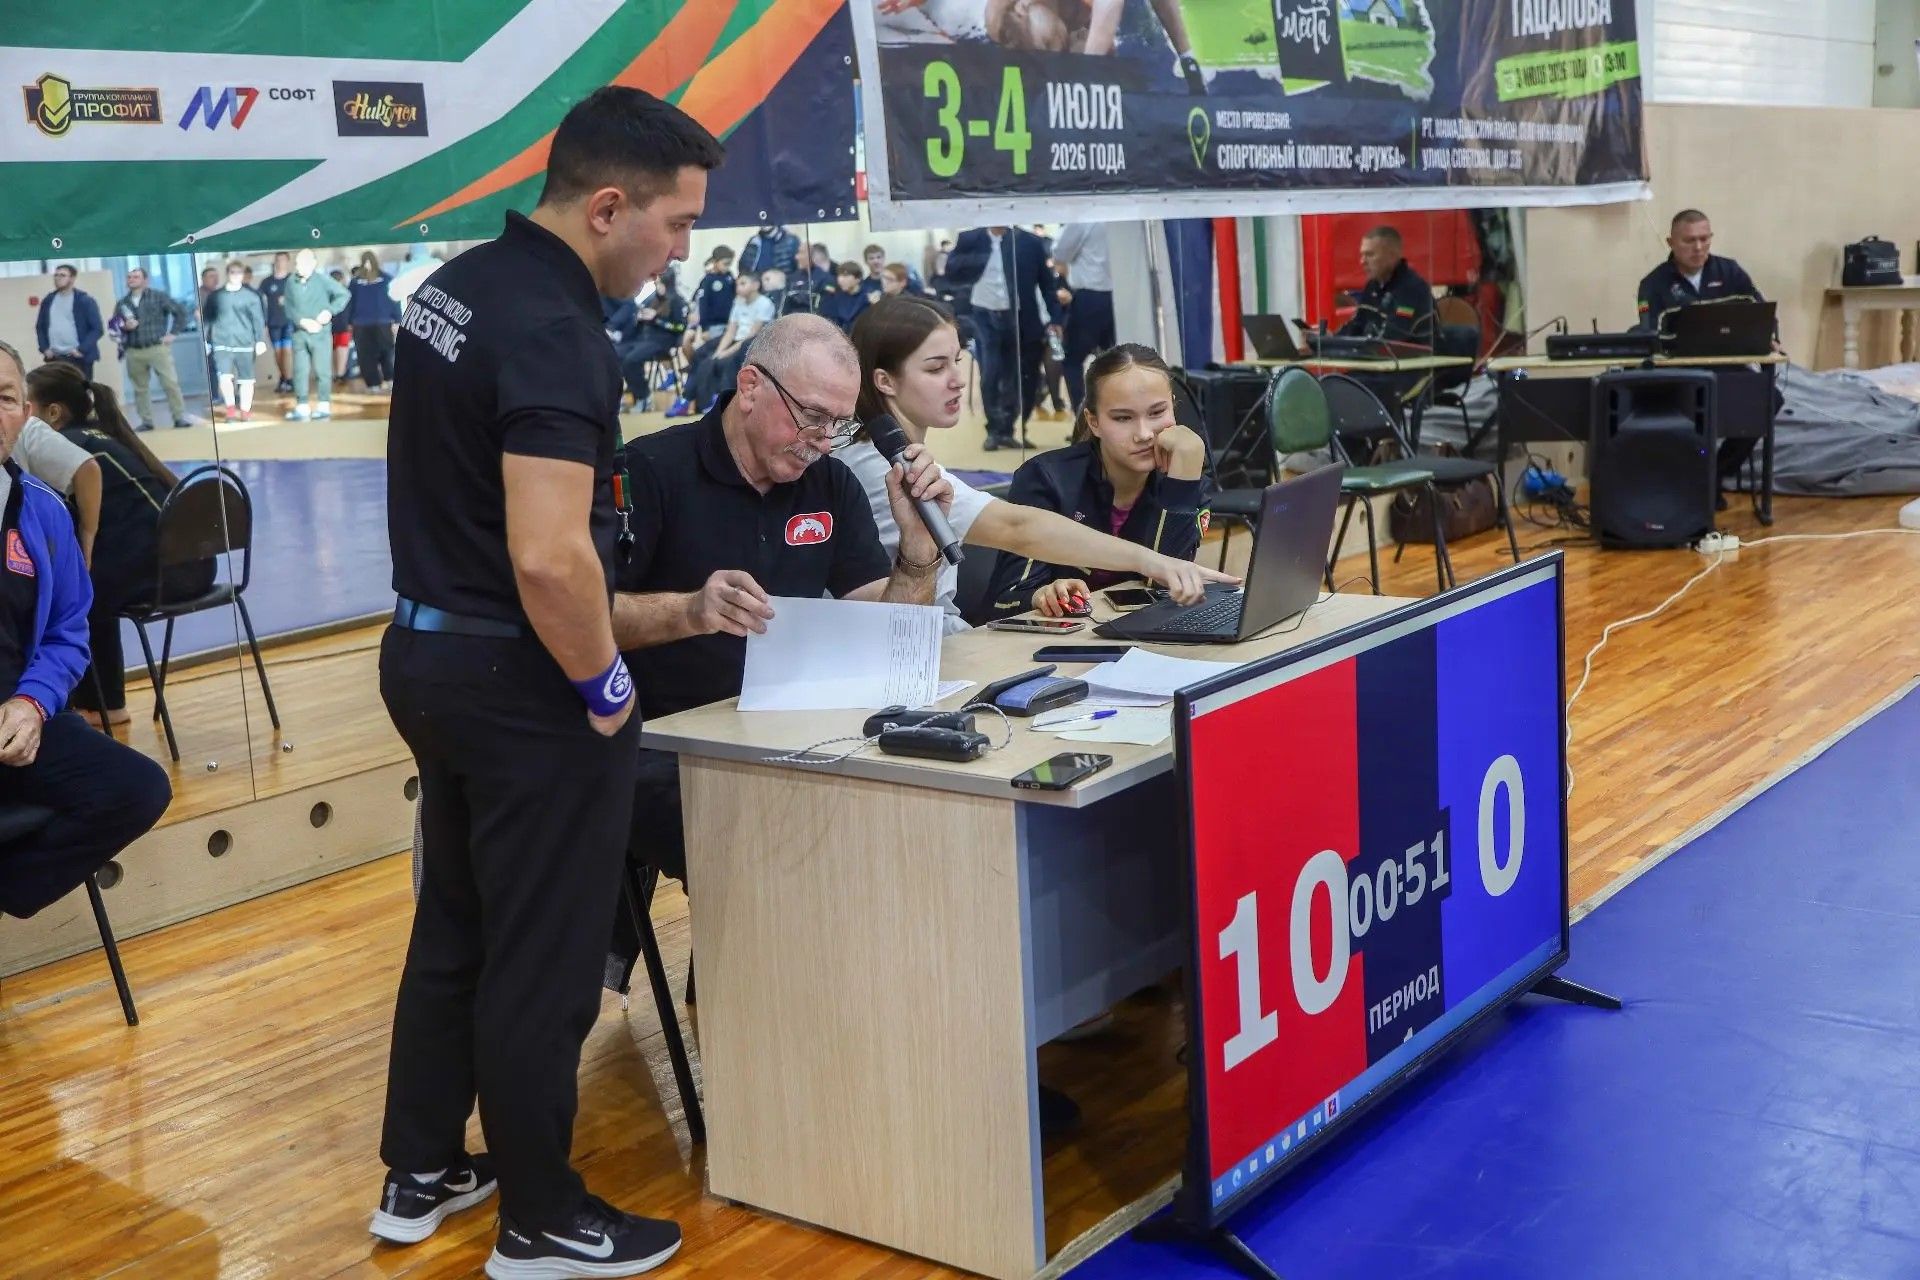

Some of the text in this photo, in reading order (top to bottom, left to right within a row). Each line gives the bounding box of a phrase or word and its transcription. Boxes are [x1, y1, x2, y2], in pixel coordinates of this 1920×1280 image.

[73, 93, 152, 101] ГРУППА КОМПАНИЙ
[75, 103, 152, 118] ПРОФИТ
[269, 87, 316, 101] СОФТ
[1046, 81, 1124, 130] ИЮЛЯ
[923, 61, 1032, 177] 3-4
[1216, 110, 1241, 129] МЕСТО
[1051, 142, 1126, 174] 2026 ГОДА
[1217, 139, 1406, 172] СПОРТИВНЫЙ КОМПЛЕКС «ДРУЖБА»
[419, 284, 473, 326] UNITED WORLD
[400, 301, 467, 362] WRESTLING
[1477, 754, 1525, 897] 0
[1350, 829, 1450, 938] 00:51
[1218, 849, 1350, 1072] 10
[1369, 964, 1440, 1036] ПЕРИОД
